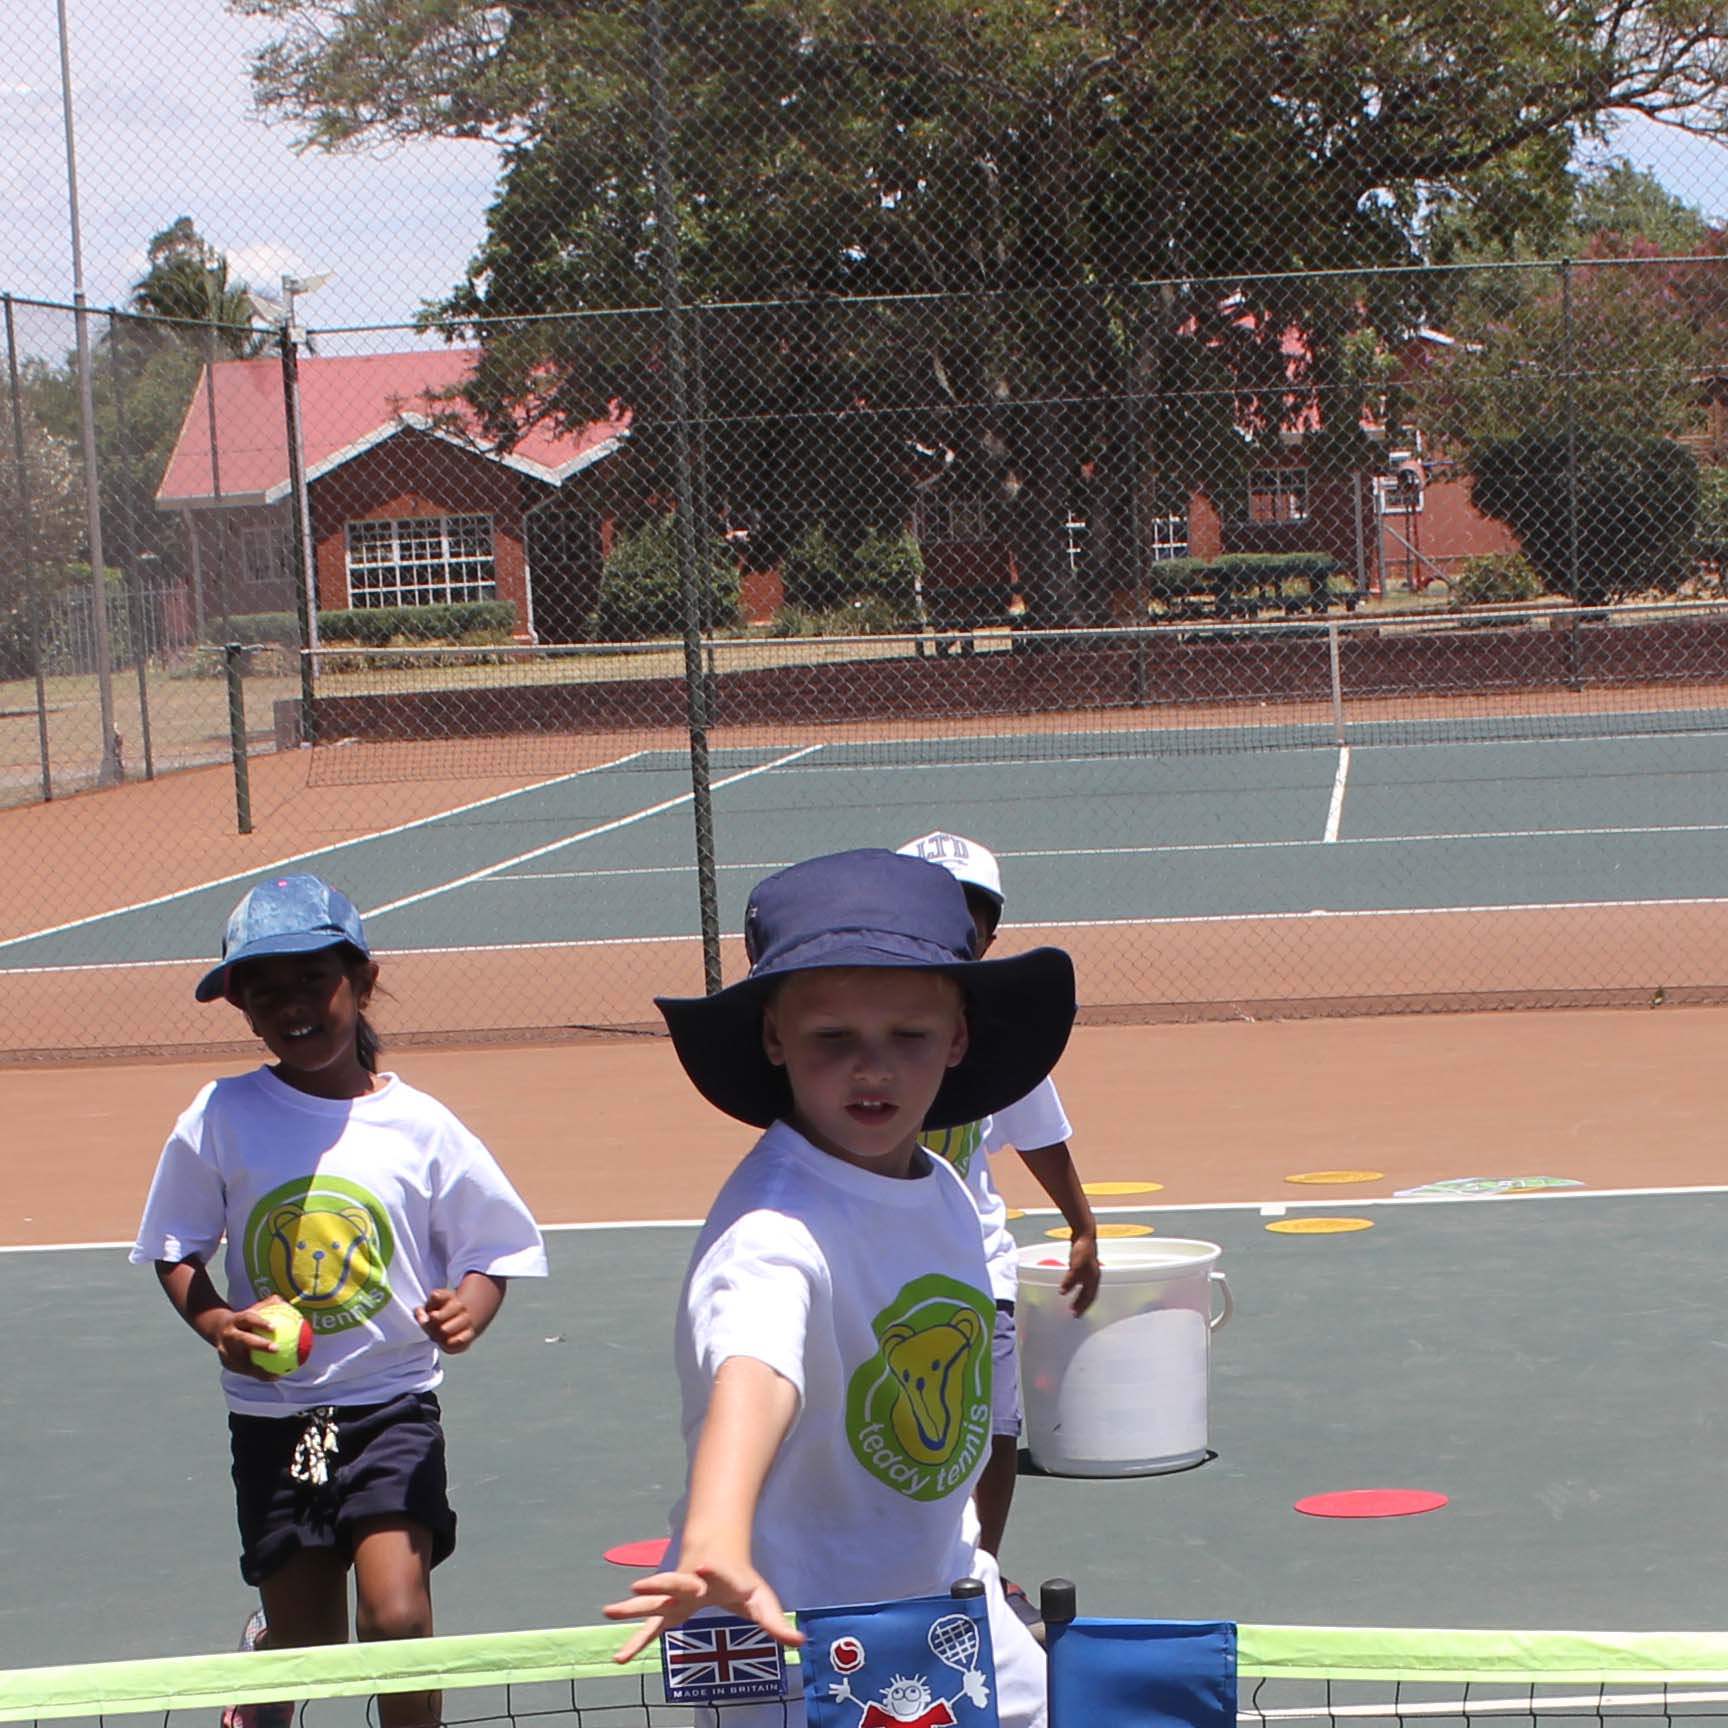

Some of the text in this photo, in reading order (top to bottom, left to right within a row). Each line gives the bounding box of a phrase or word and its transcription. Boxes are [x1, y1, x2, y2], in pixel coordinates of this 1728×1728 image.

[858, 1403, 989, 1495] teddy tennis
[673, 1683, 779, 1698] MADE IN BRITAIN
